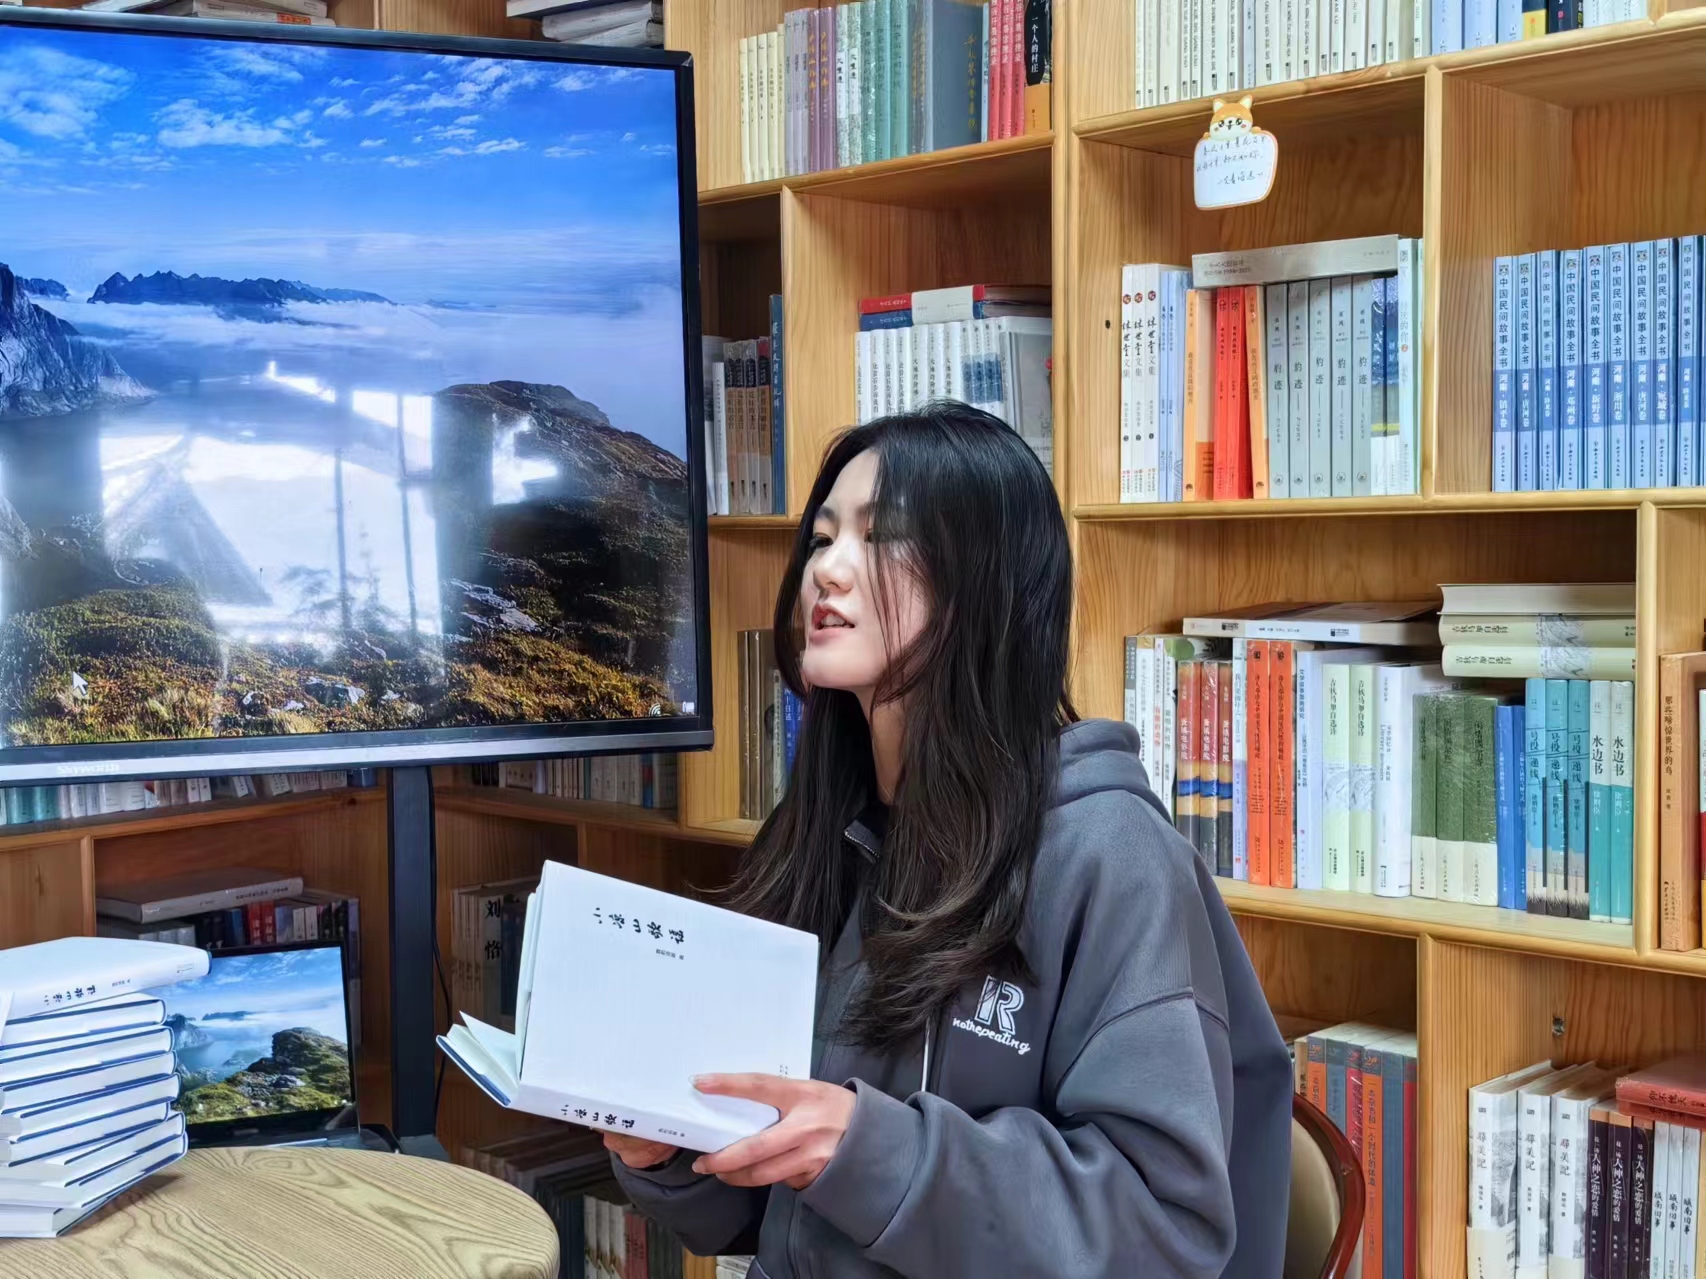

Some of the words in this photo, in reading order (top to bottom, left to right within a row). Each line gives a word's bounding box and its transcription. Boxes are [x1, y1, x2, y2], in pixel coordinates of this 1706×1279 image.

[1031, 16, 1039, 73] 一个人的村庄
[1499, 278, 1509, 368] 中国民间故事全书
[1520, 276, 1529, 365] 中国民间故事全书
[1566, 272, 1576, 364] 中国民间故事全书
[1590, 269, 1601, 362] 中国民间故事全书
[1612, 265, 1622, 358] 中国民间故事全书
[1637, 264, 1647, 356] 中国民间故事全书
[1657, 262, 1667, 356] 中国民间故事全书
[1273, 364, 1283, 391] 豹迹
[1293, 361, 1304, 390] 豹迹
[1315, 356, 1324, 385] 豹迹
[1337, 358, 1347, 386] 豹迹
[1358, 356, 1368, 385] 豹迹
[1592, 735, 1604, 775] 水边书
[1612, 736, 1624, 777] 水边书
[1654, 1191, 1663, 1228] 城南旧事
[1669, 1193, 1678, 1231] 城南旧事
[1683, 1197, 1692, 1236] 城南旧事
